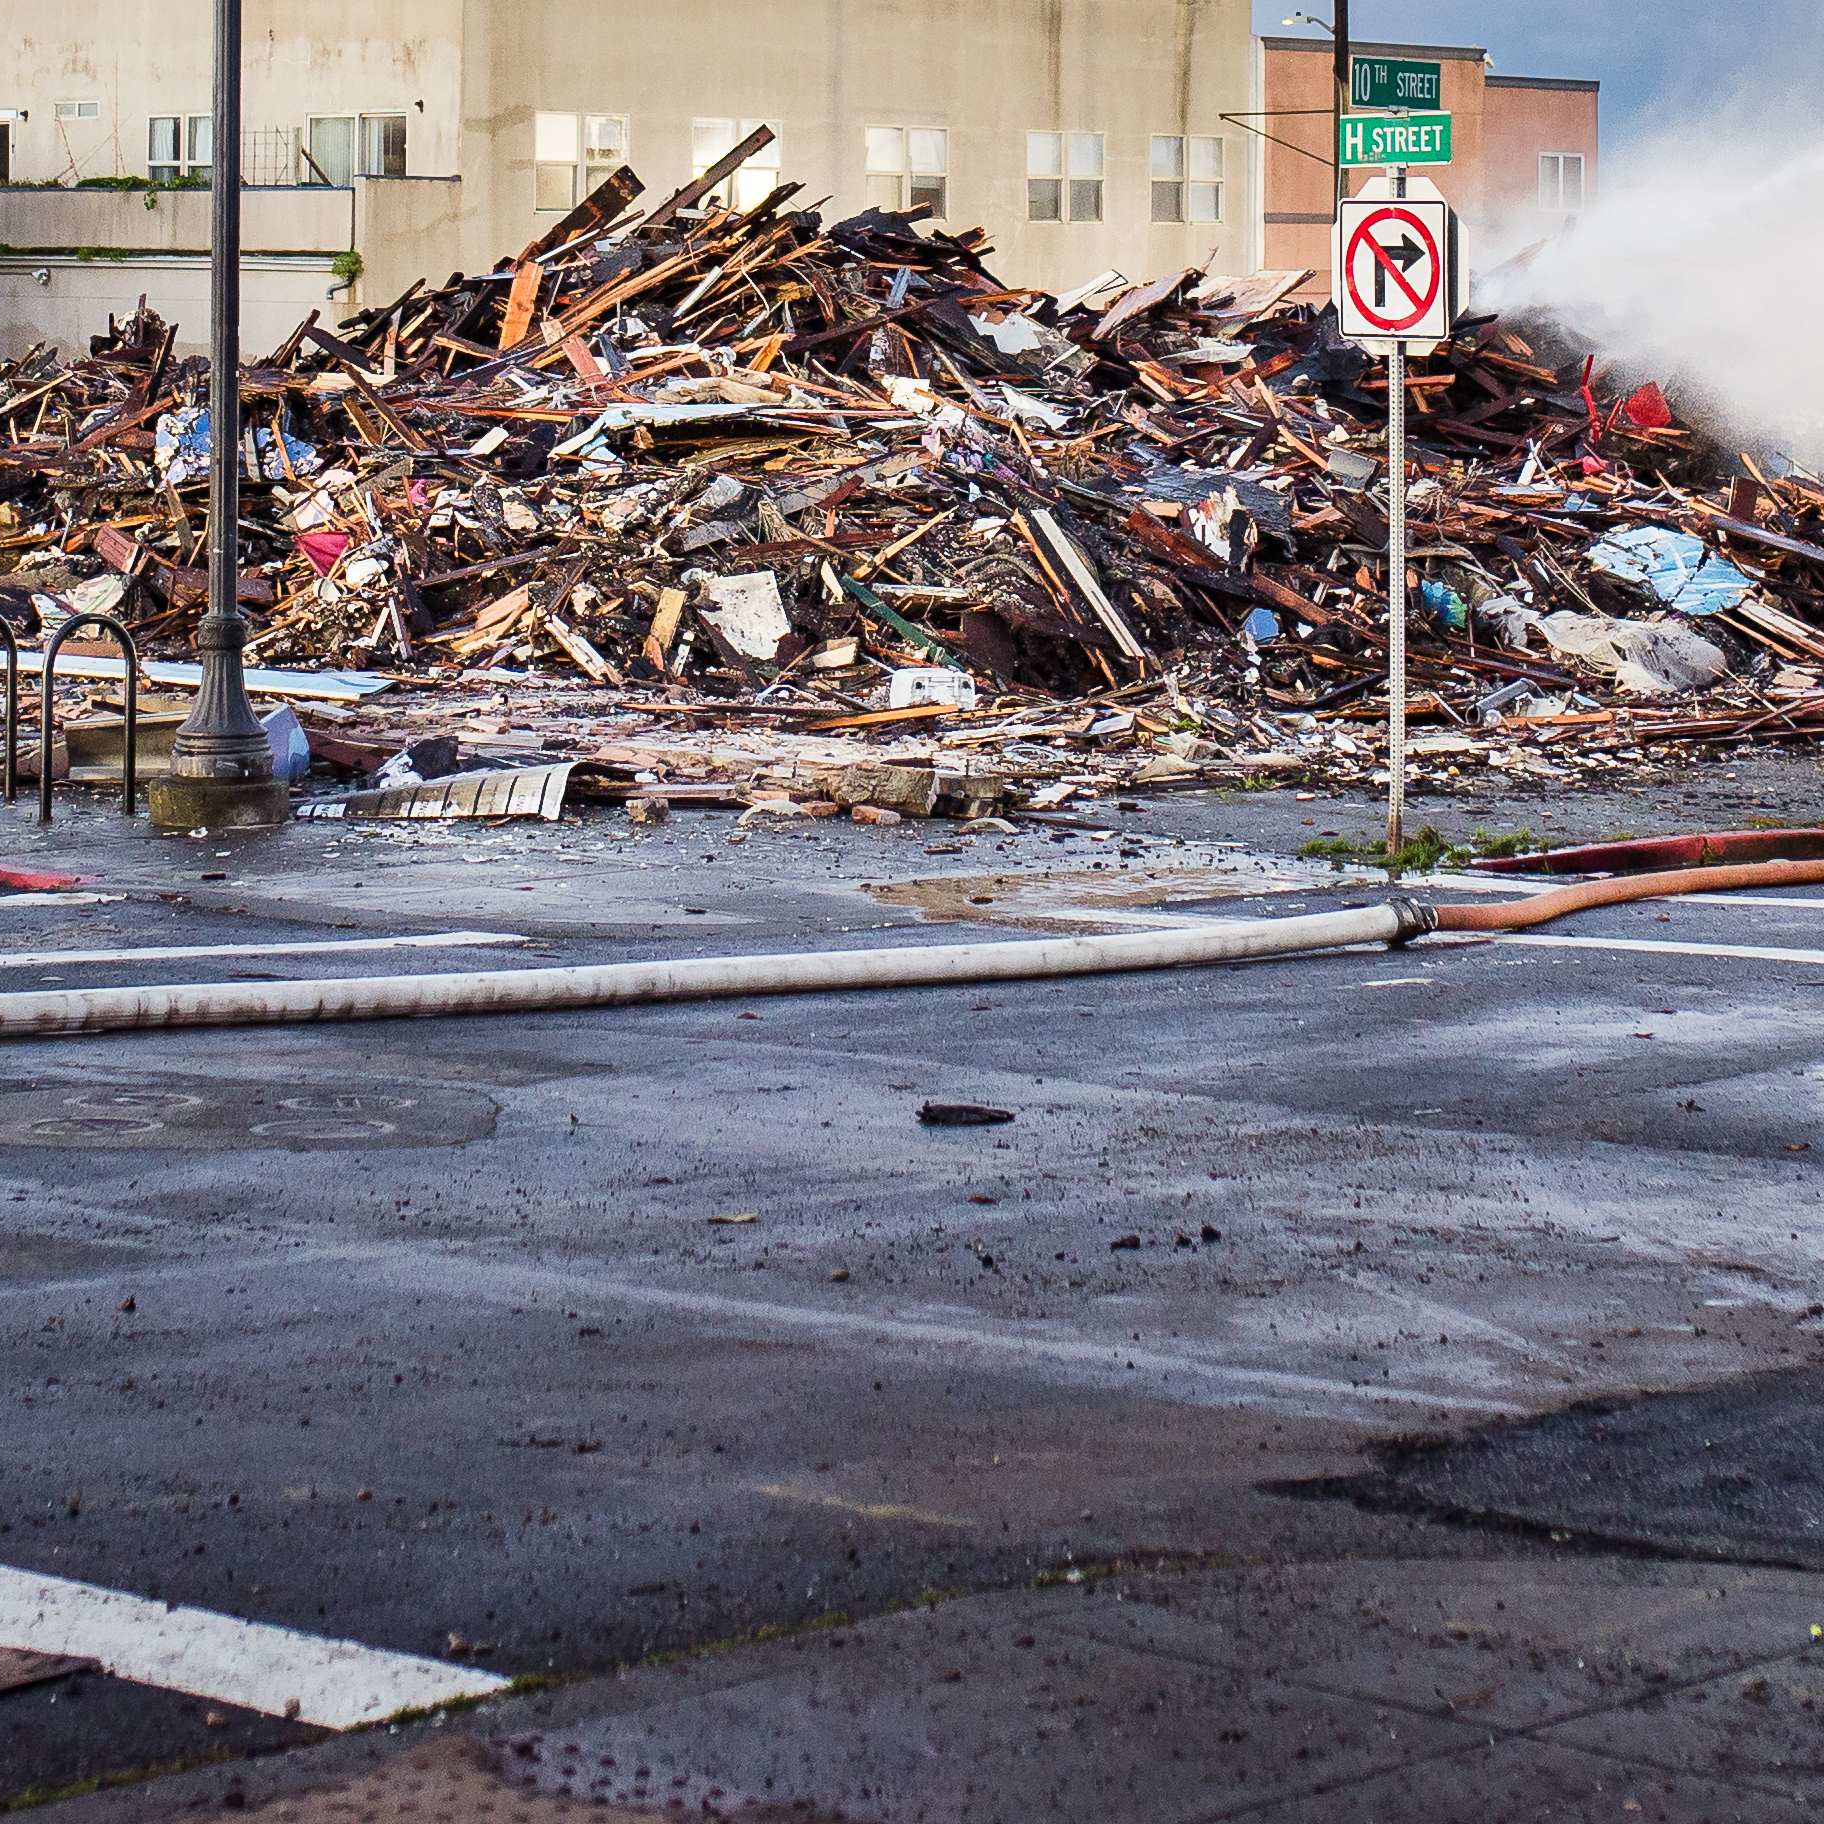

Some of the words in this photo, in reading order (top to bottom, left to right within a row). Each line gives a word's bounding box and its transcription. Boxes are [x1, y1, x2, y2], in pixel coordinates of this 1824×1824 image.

[1397, 72, 1438, 99] STREET
[1345, 123, 1364, 161] H
[1371, 125, 1444, 153] STREET
